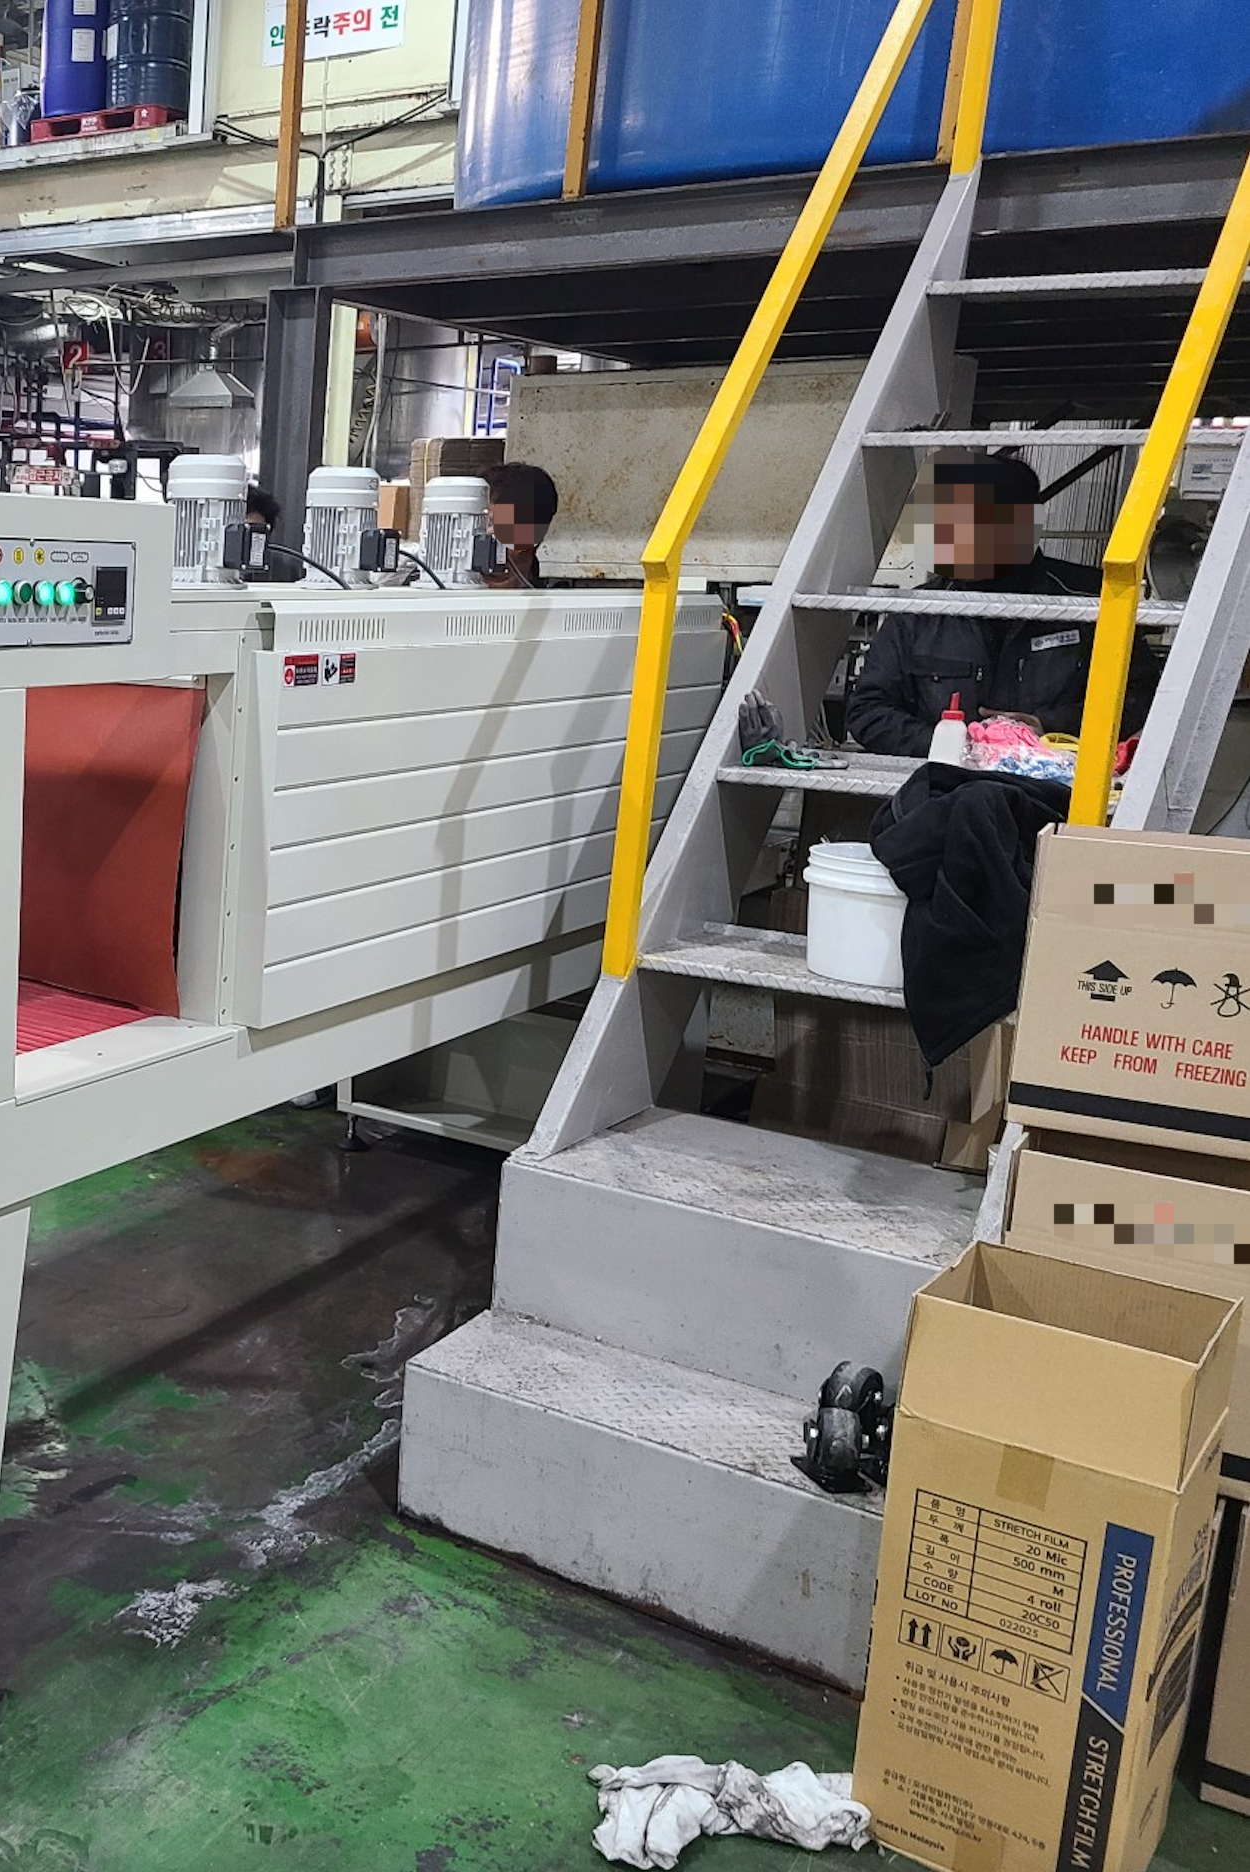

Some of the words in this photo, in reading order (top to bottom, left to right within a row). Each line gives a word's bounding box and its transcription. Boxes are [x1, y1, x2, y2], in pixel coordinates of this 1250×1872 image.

[305, 8, 372, 37] 락주의
[380, 5, 399, 29] 전
[69, 344, 82, 368] 2
[1078, 980, 1096, 992] THIS
[1100, 983, 1118, 994] SIDE
[1120, 986, 1132, 996] UP
[1081, 1023, 1140, 1047] HANDLE
[1146, 1032, 1186, 1053] WITH
[1192, 1039, 1234, 1060] CARE
[1060, 1045, 1097, 1065] KEEP
[1114, 1053, 1158, 1074] FROM
[1175, 1062, 1247, 1087] FREEZING
[994, 1518, 1041, 1541] STRETCH
[1043, 1535, 1069, 1550] FILM
[923, 1561, 933, 1570] 수
[950, 1553, 960, 1564] 이
[1026, 1545, 1041, 1556] 20
[1046, 1551, 1067, 1566] Mic
[1013, 1557, 1035, 1572] 500
[1040, 1565, 1065, 1581] mm
[923, 1576, 954, 1593] CODE
[1053, 1586, 1064, 1597] M
[915, 1590, 935, 1603] LOT
[942, 1598, 958, 1610] NO
[1027, 1595, 1035, 1604] 4
[1040, 1599, 1061, 1613] roll
[999, 1619, 1038, 1638] 022025
[1021, 1610, 1060, 1630] 20C50
[1096, 1553, 1138, 1692] PROFESSIONAL
[970, 1684, 1010, 1707] 주의사항
[1071, 1735, 1110, 1869] STRETCHFILM
[910, 1830, 945, 1852] Malaysia
